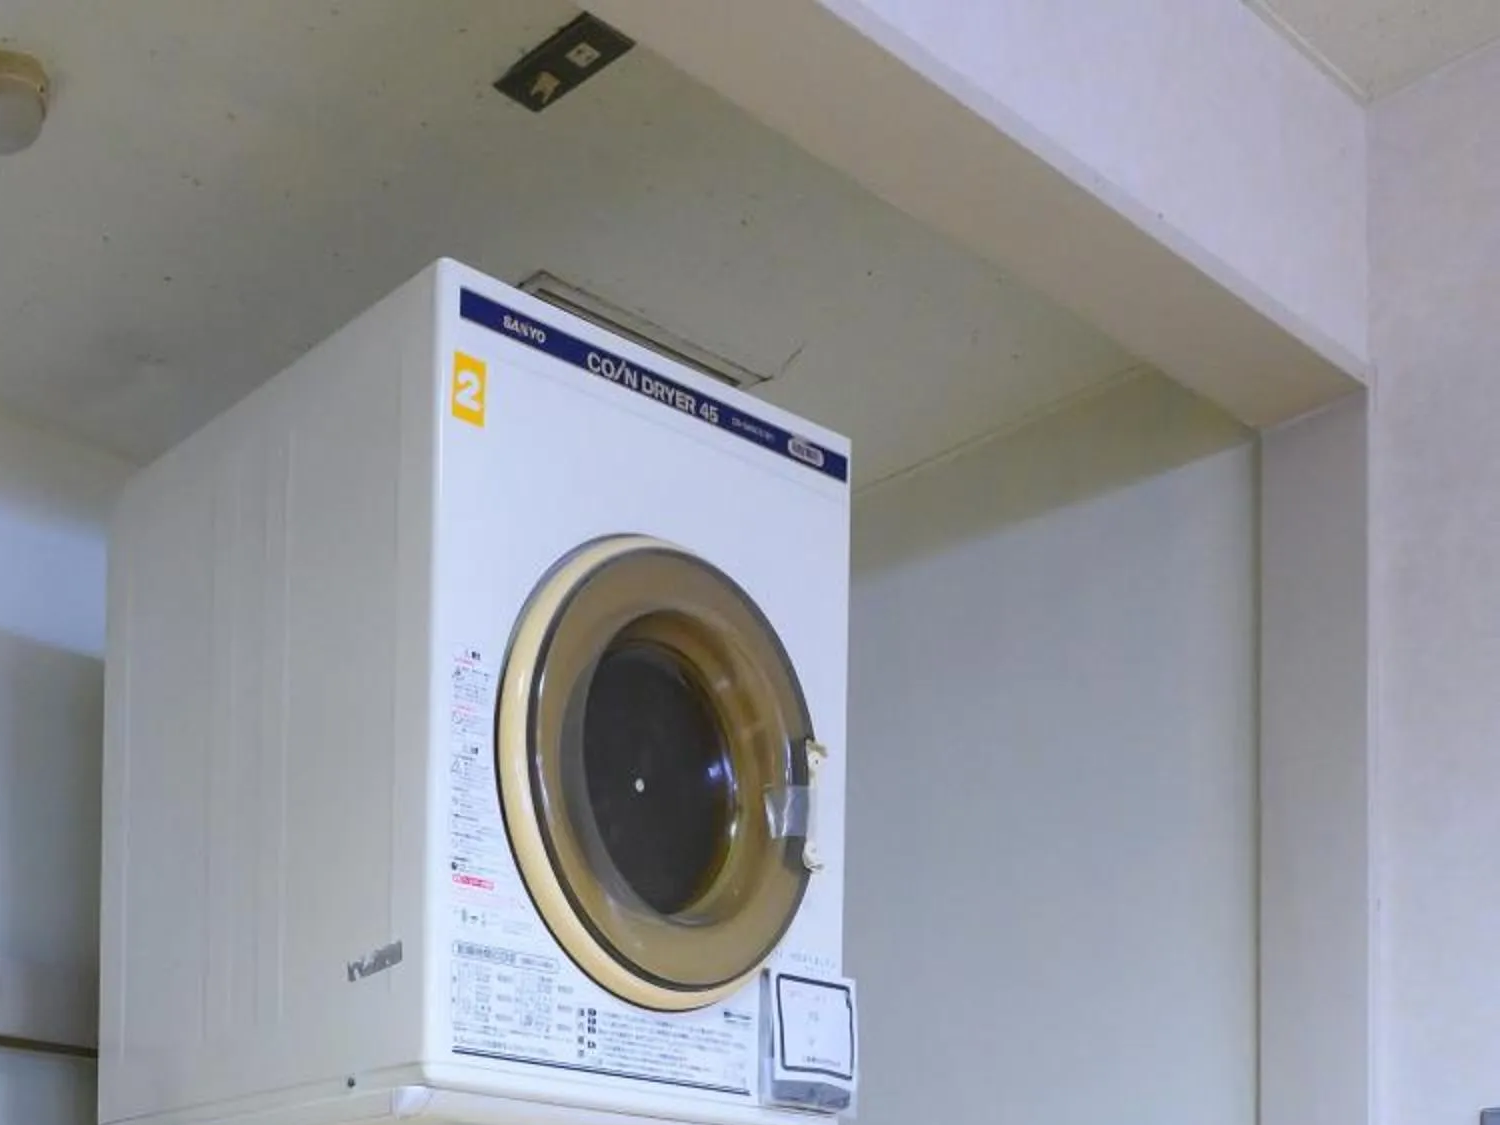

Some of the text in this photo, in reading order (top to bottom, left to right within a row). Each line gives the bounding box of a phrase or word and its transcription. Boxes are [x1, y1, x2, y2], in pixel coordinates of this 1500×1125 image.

[455, 369, 482, 412] 2
[503, 315, 546, 344] SANYO
[642, 376, 696, 415] DRYER
[700, 402, 719, 424] 45
